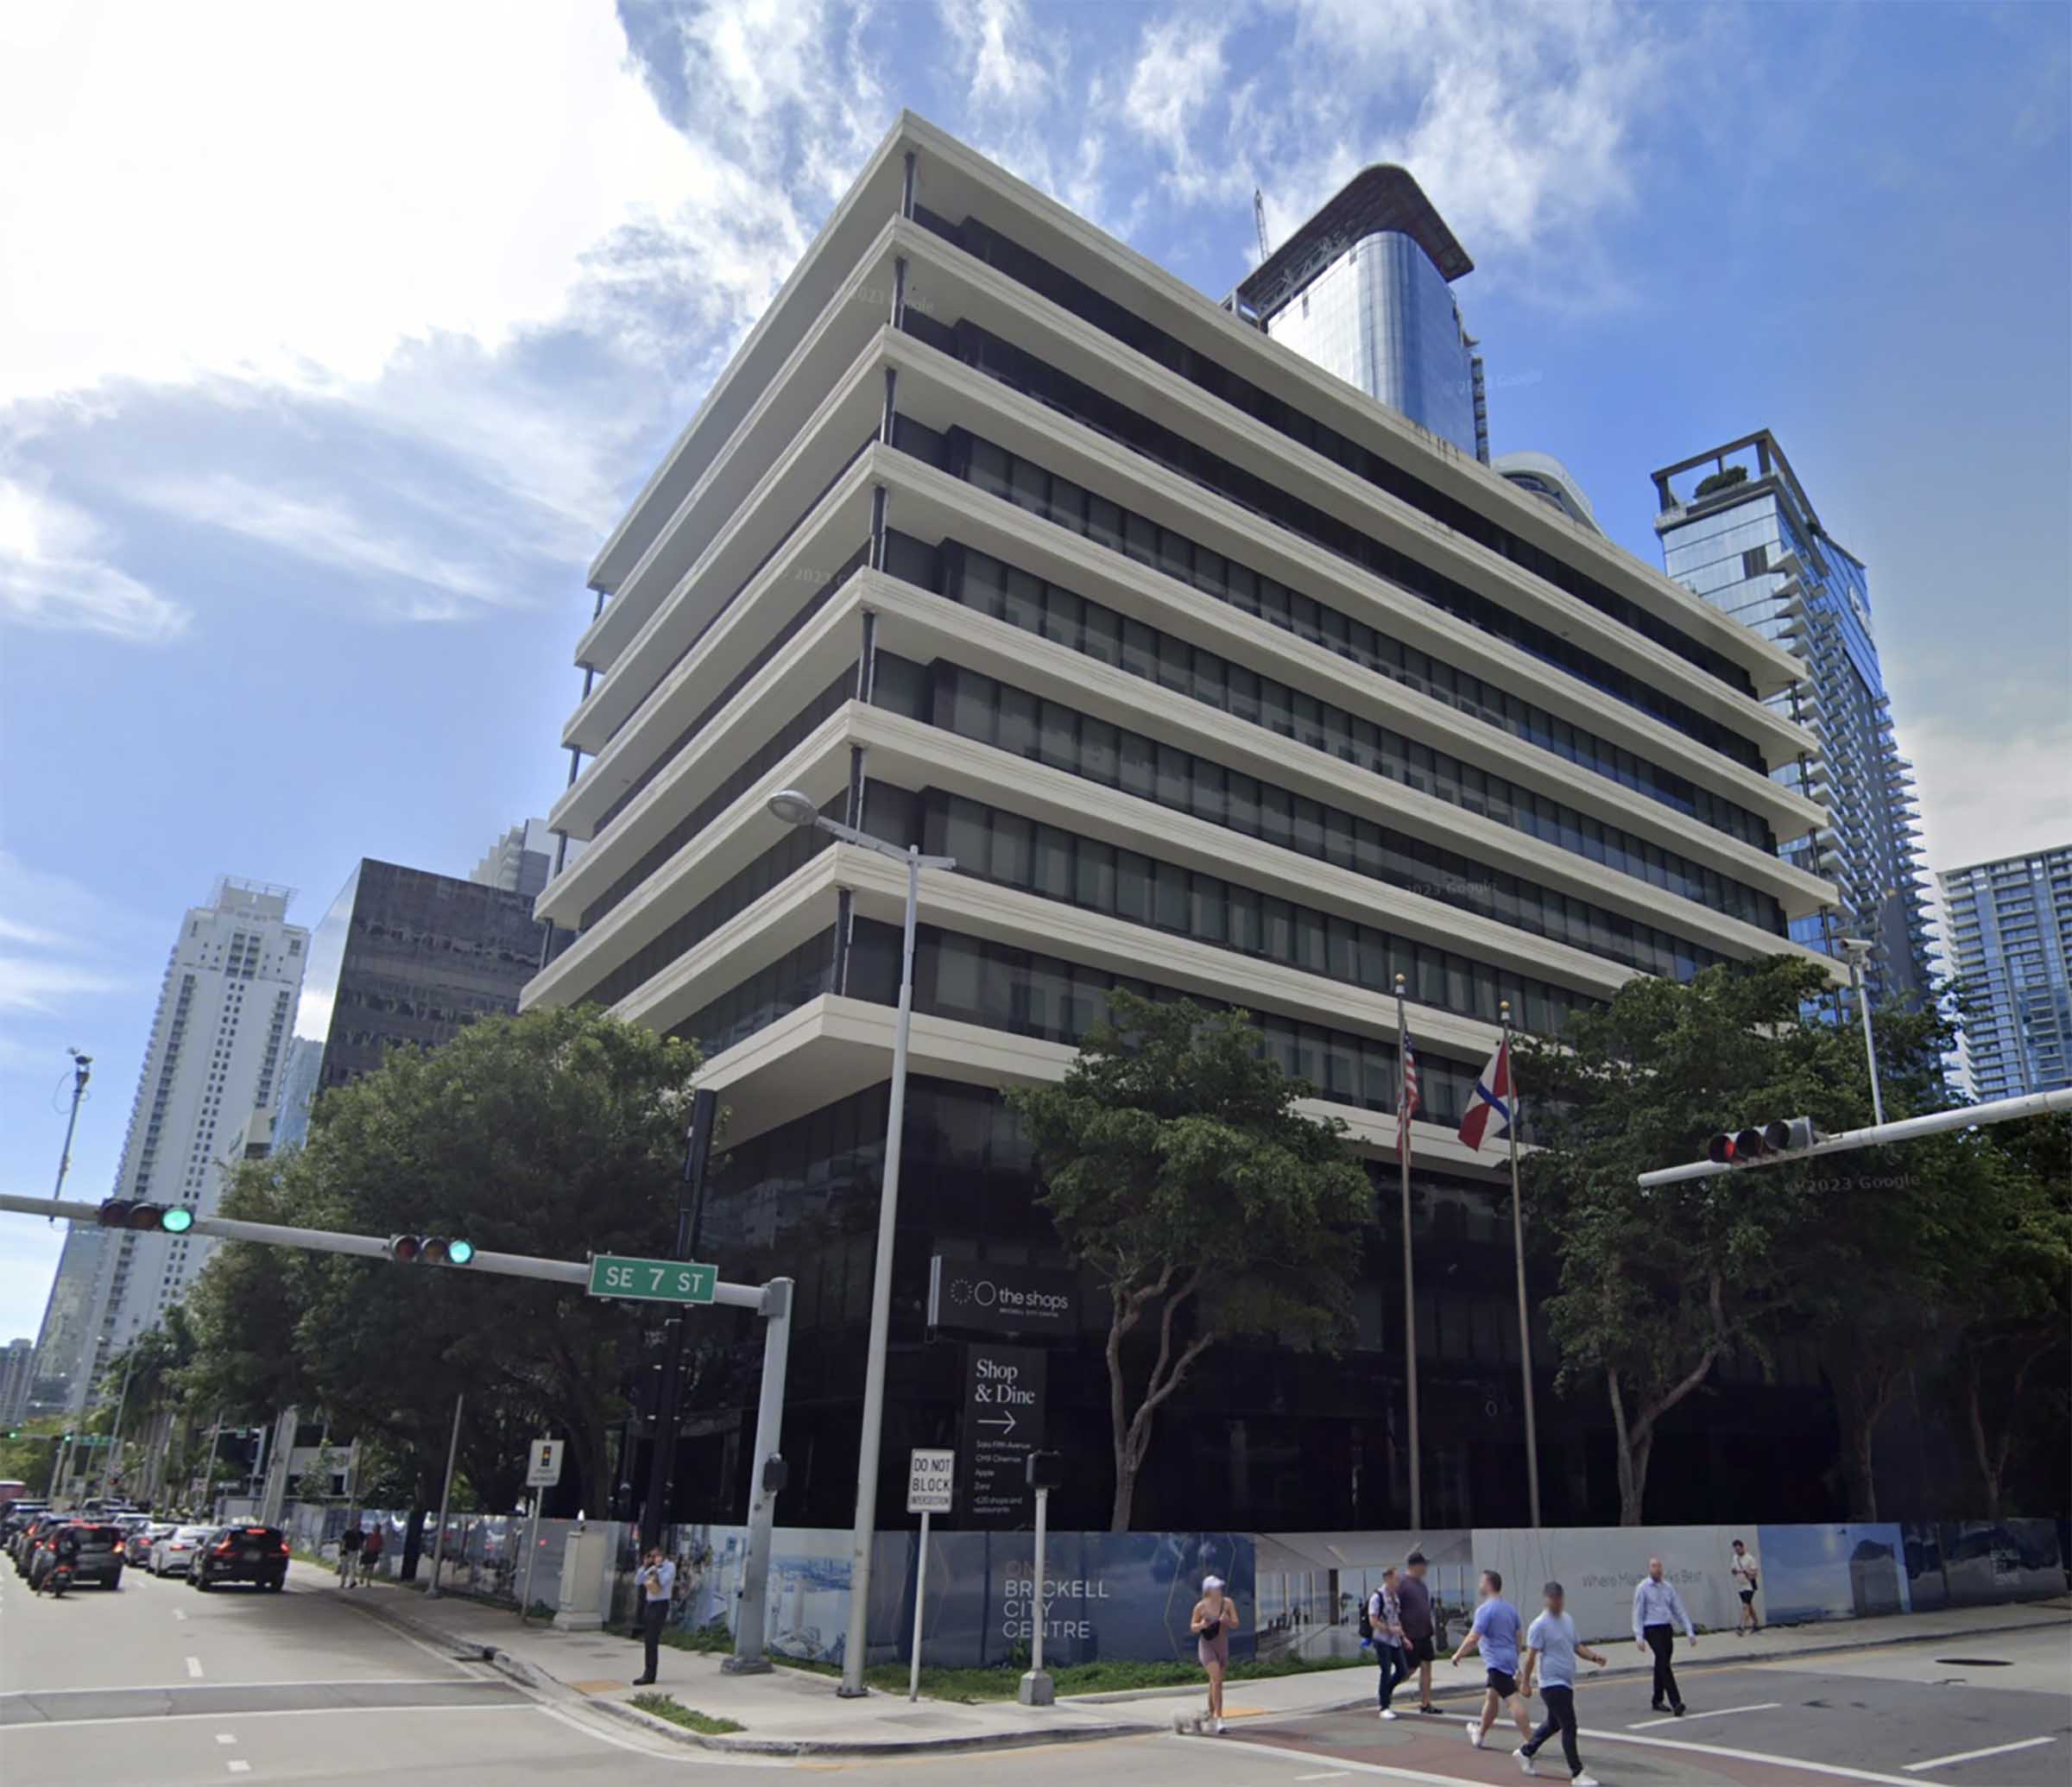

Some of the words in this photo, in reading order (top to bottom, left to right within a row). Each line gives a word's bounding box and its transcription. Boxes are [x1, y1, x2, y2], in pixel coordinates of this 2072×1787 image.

[605, 1266, 635, 1288] SE
[648, 1268, 665, 1291] 7
[677, 1272, 704, 1293] ST
[999, 1287, 1024, 1304] the
[1026, 1291, 1069, 1310] shops
[976, 1359, 1018, 1383] Shop
[975, 1385, 992, 1403] &
[995, 1384, 1035, 1405] Dine
[914, 1458, 929, 1472] DO
[932, 1459, 951, 1473] NOT
[912, 1477, 951, 1492] BLOCK
[1004, 1580, 1109, 1598] BRCKELL
